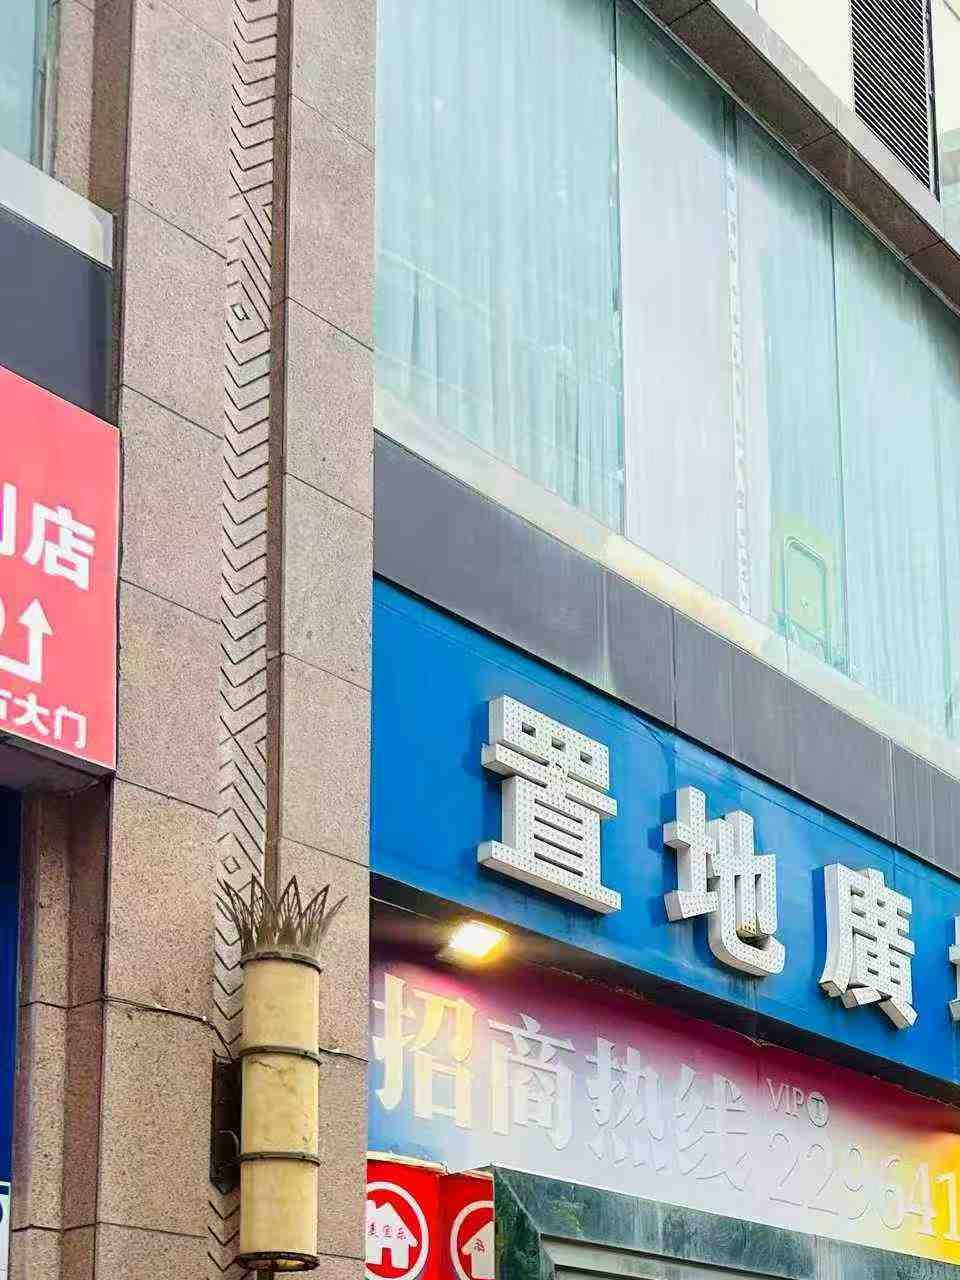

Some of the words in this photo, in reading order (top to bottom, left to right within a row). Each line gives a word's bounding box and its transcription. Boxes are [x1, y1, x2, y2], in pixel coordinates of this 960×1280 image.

[0, 483, 95, 590] 店
[372, 973, 751, 1190] 招商热线
